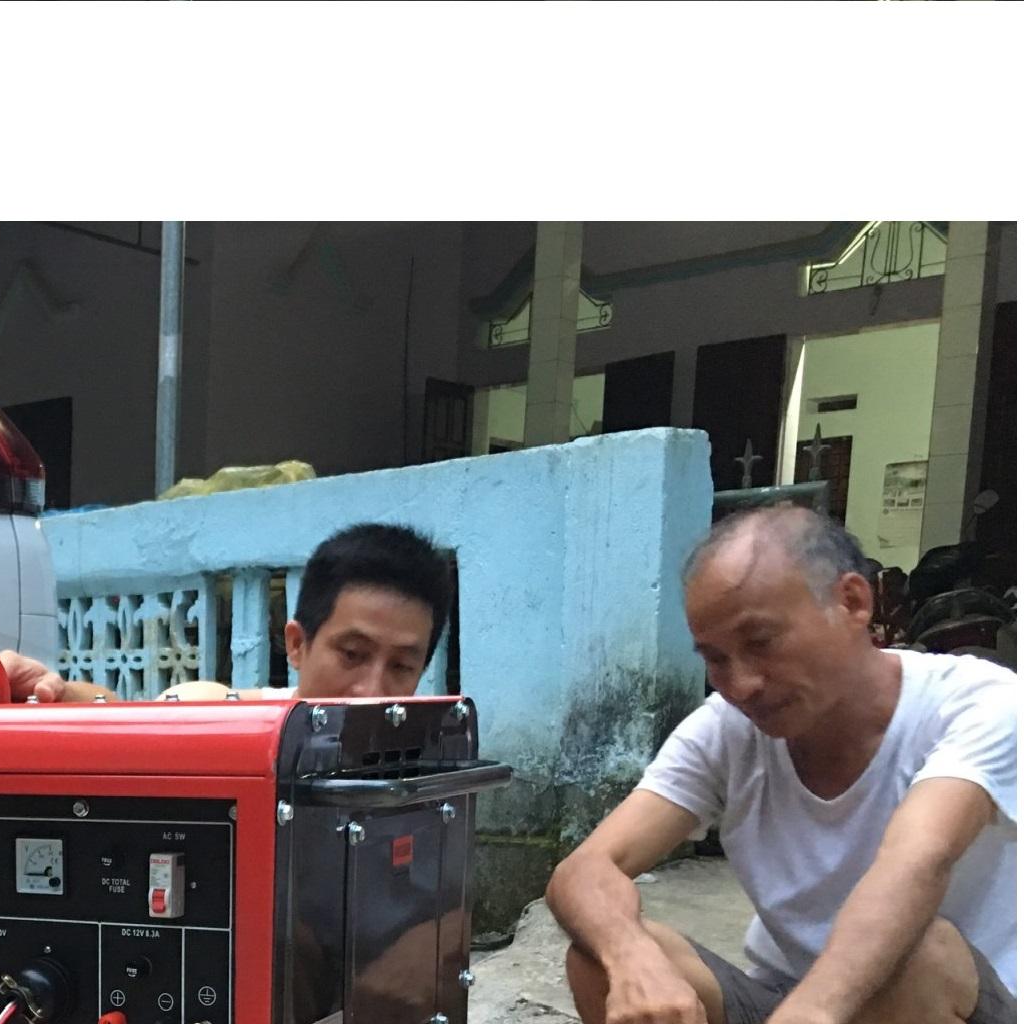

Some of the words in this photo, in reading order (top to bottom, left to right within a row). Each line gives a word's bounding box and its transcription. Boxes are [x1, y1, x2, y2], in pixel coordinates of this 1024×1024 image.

[163, 832, 172, 841] AC
[111, 878, 130, 887] TOTAL
[108, 886, 125, 894] FUSE
[121, 928, 131, 937] DC
[132, 929, 145, 937] 12V
